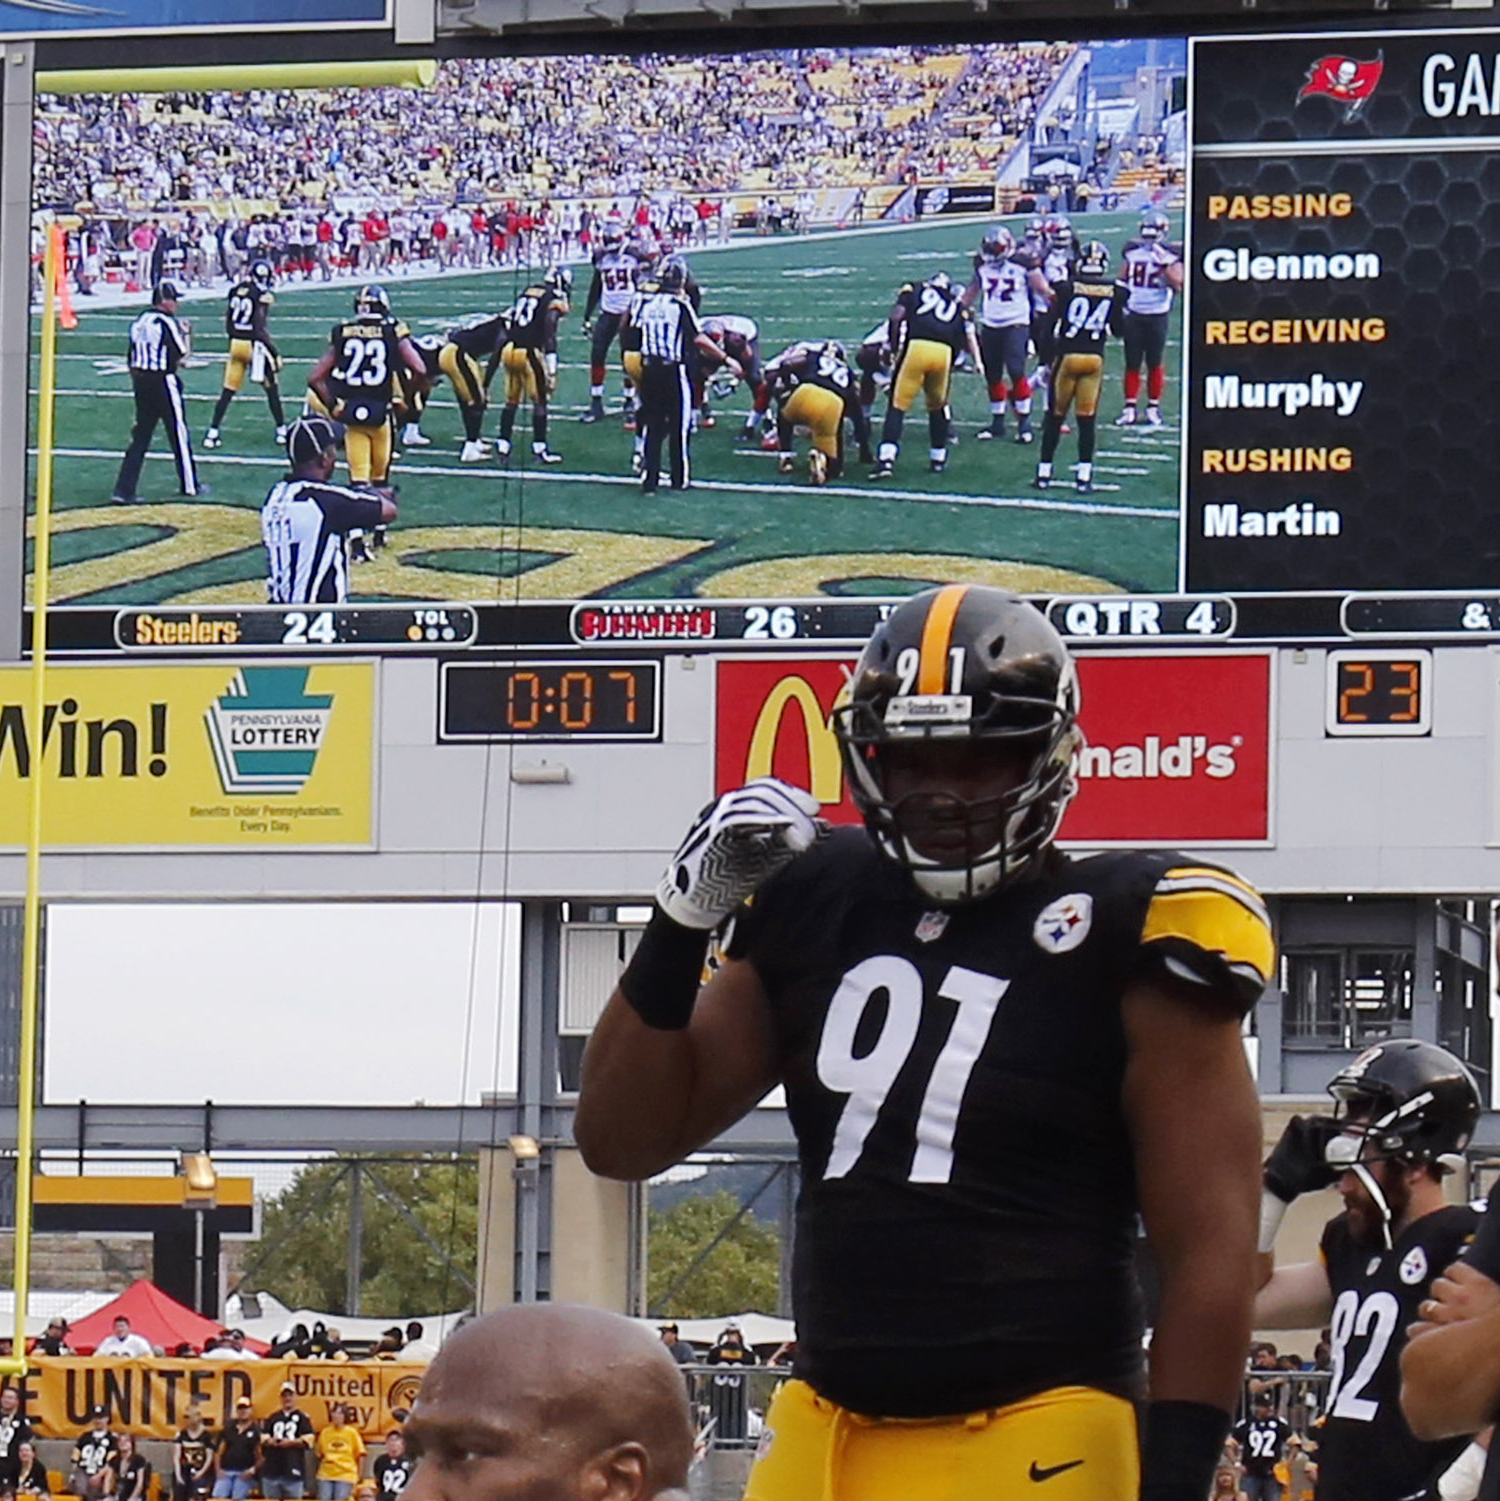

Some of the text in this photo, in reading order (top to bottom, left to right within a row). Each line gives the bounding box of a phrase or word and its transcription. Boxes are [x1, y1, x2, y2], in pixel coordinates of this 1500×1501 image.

[1208, 193, 1352, 220] PASSING
[1203, 249, 1380, 282] Glennon
[1206, 317, 1387, 347] RECEIVING
[343, 338, 387, 386] 23
[1204, 375, 1363, 415] Murphy
[1202, 447, 1353, 474] RUSHING
[1203, 503, 1341, 538] Martin
[136, 610, 450, 645] Steelers 24 TOL
[744, 606, 796, 640] 26
[1065, 602, 1218, 637] QTR 4
[1462, 602, 1490, 630] &
[507, 671, 636, 729] 0:07
[1340, 663, 1418, 722] 23
[231, 714, 322, 726] PENNSYLVANIA
[231, 728, 321, 745] LOTTERY
[1071, 736, 1236, 778] nald's
[816, 953, 1012, 1184] 91
[66, 1366, 252, 1428] UNITED
[293, 1373, 374, 1398] United
[1249, 1431, 1276, 1457] 92
